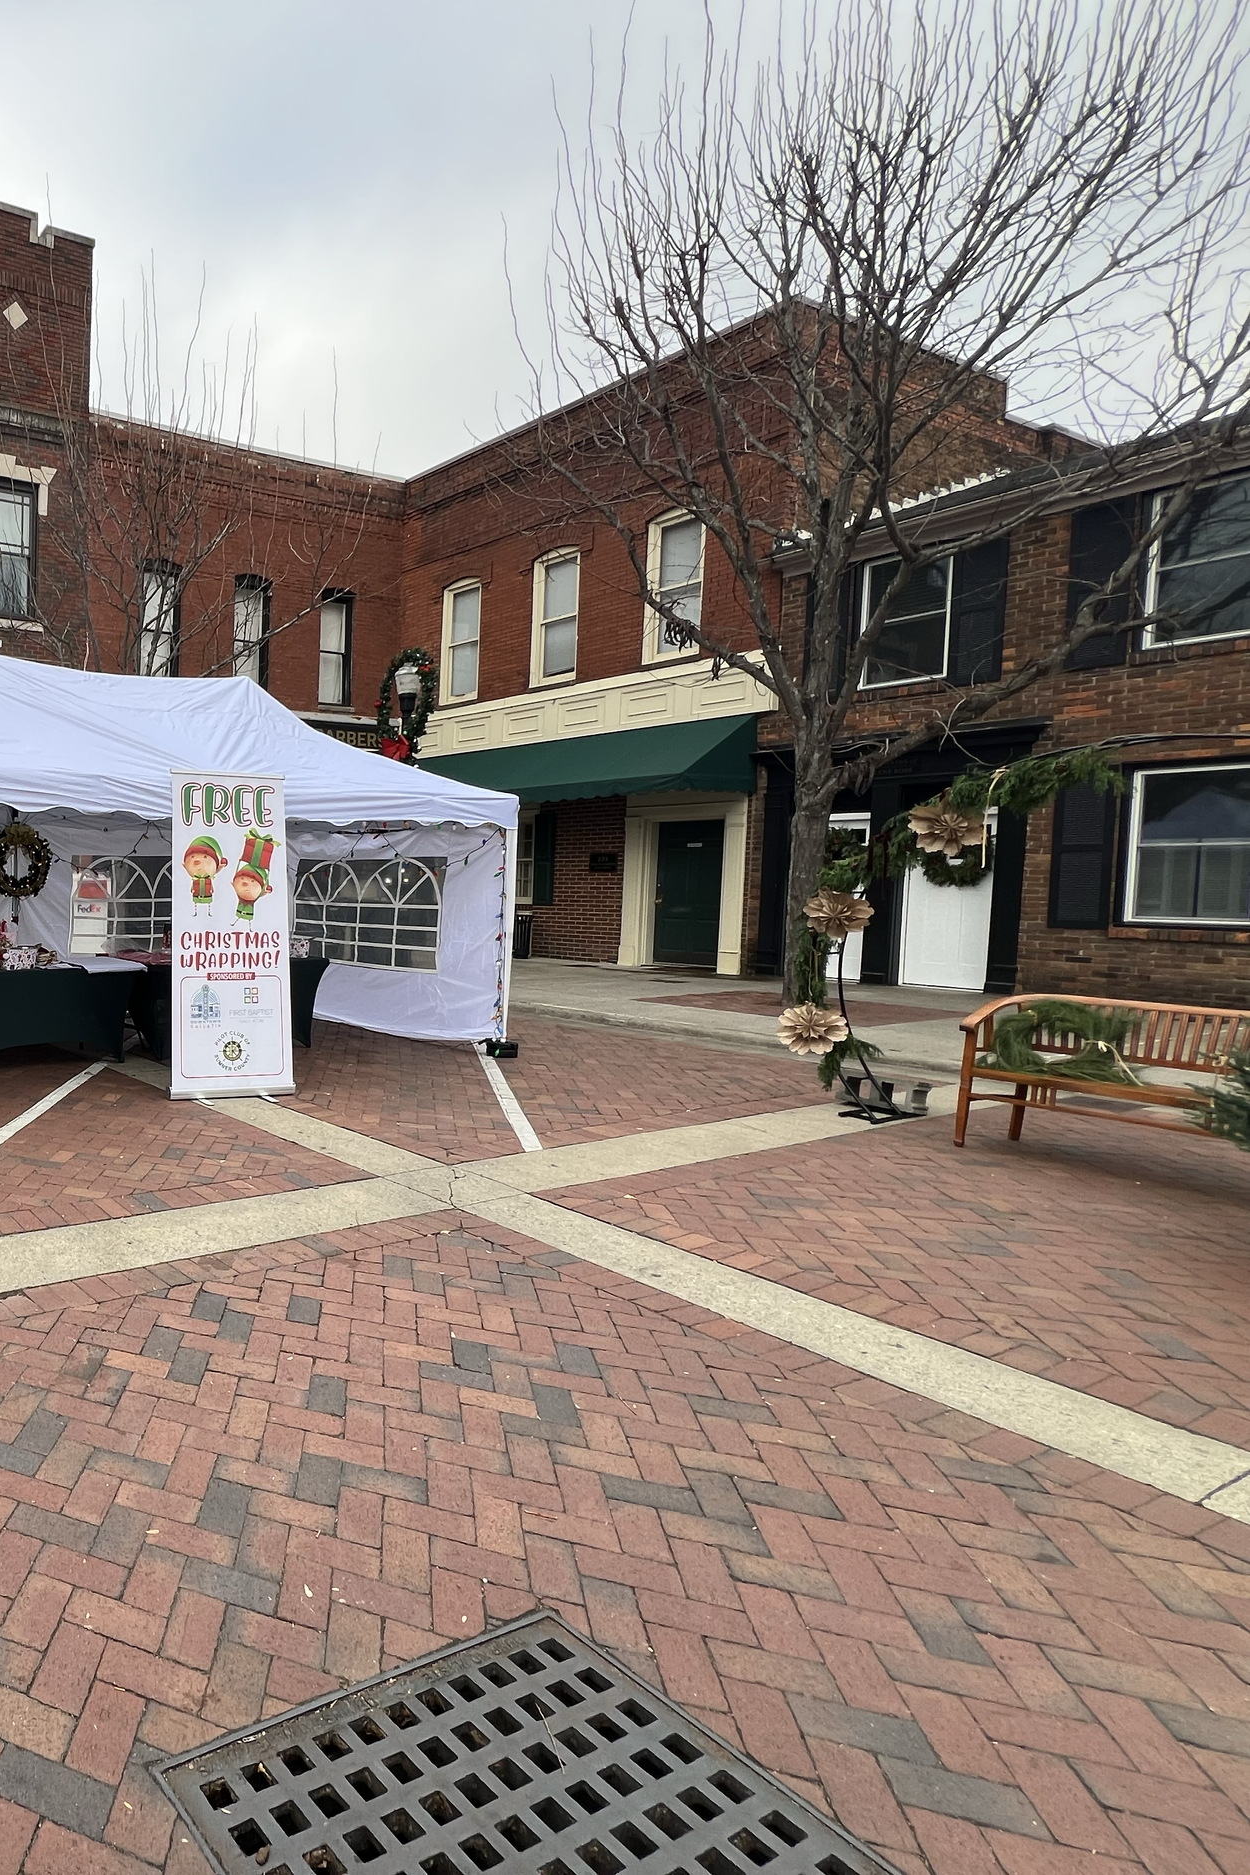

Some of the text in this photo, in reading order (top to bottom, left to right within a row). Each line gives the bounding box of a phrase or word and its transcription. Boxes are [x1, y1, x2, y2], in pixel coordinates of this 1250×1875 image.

[180, 782, 276, 828] FREE
[77, 904, 102, 914] FedEx
[180, 931, 280, 951] CHRISTMAS
[180, 950, 281, 971] WRAPPING!
[247, 1008, 274, 1016] BAPTIST
[214, 1031, 251, 1046] PILOT CLUB OF
[214, 1053, 251, 1071] SUMNER COUNTY
